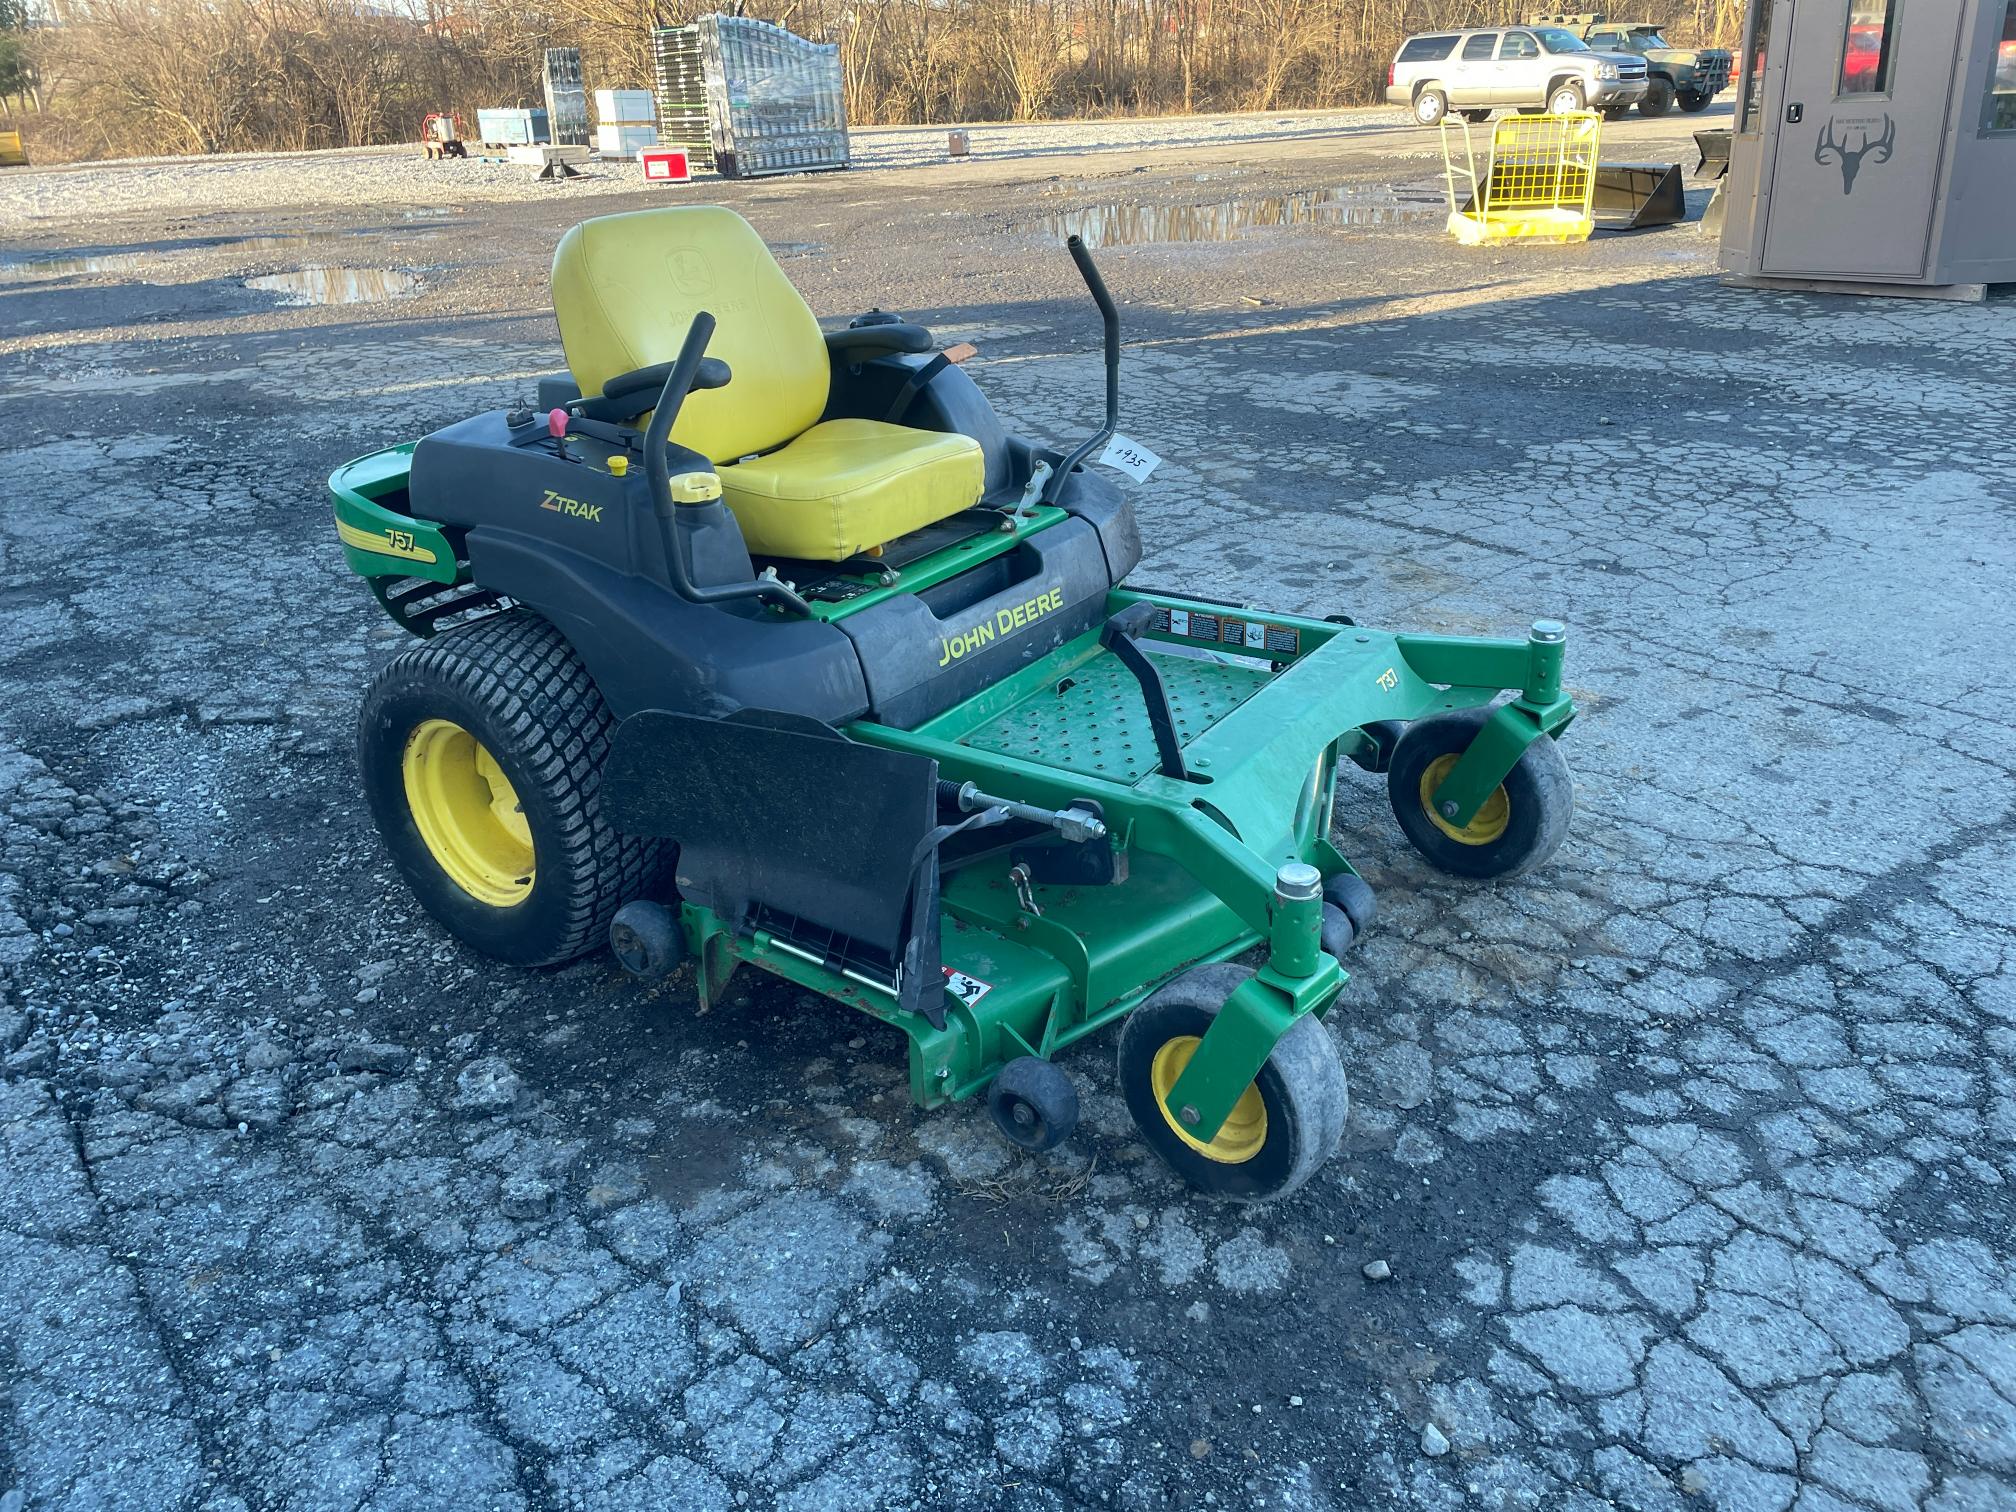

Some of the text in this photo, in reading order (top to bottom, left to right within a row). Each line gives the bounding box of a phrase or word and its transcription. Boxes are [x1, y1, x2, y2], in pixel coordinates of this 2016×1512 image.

[385, 528, 415, 551] 757
[939, 587, 1064, 667] JOHN DEERE
[1375, 667, 1399, 692] 737
